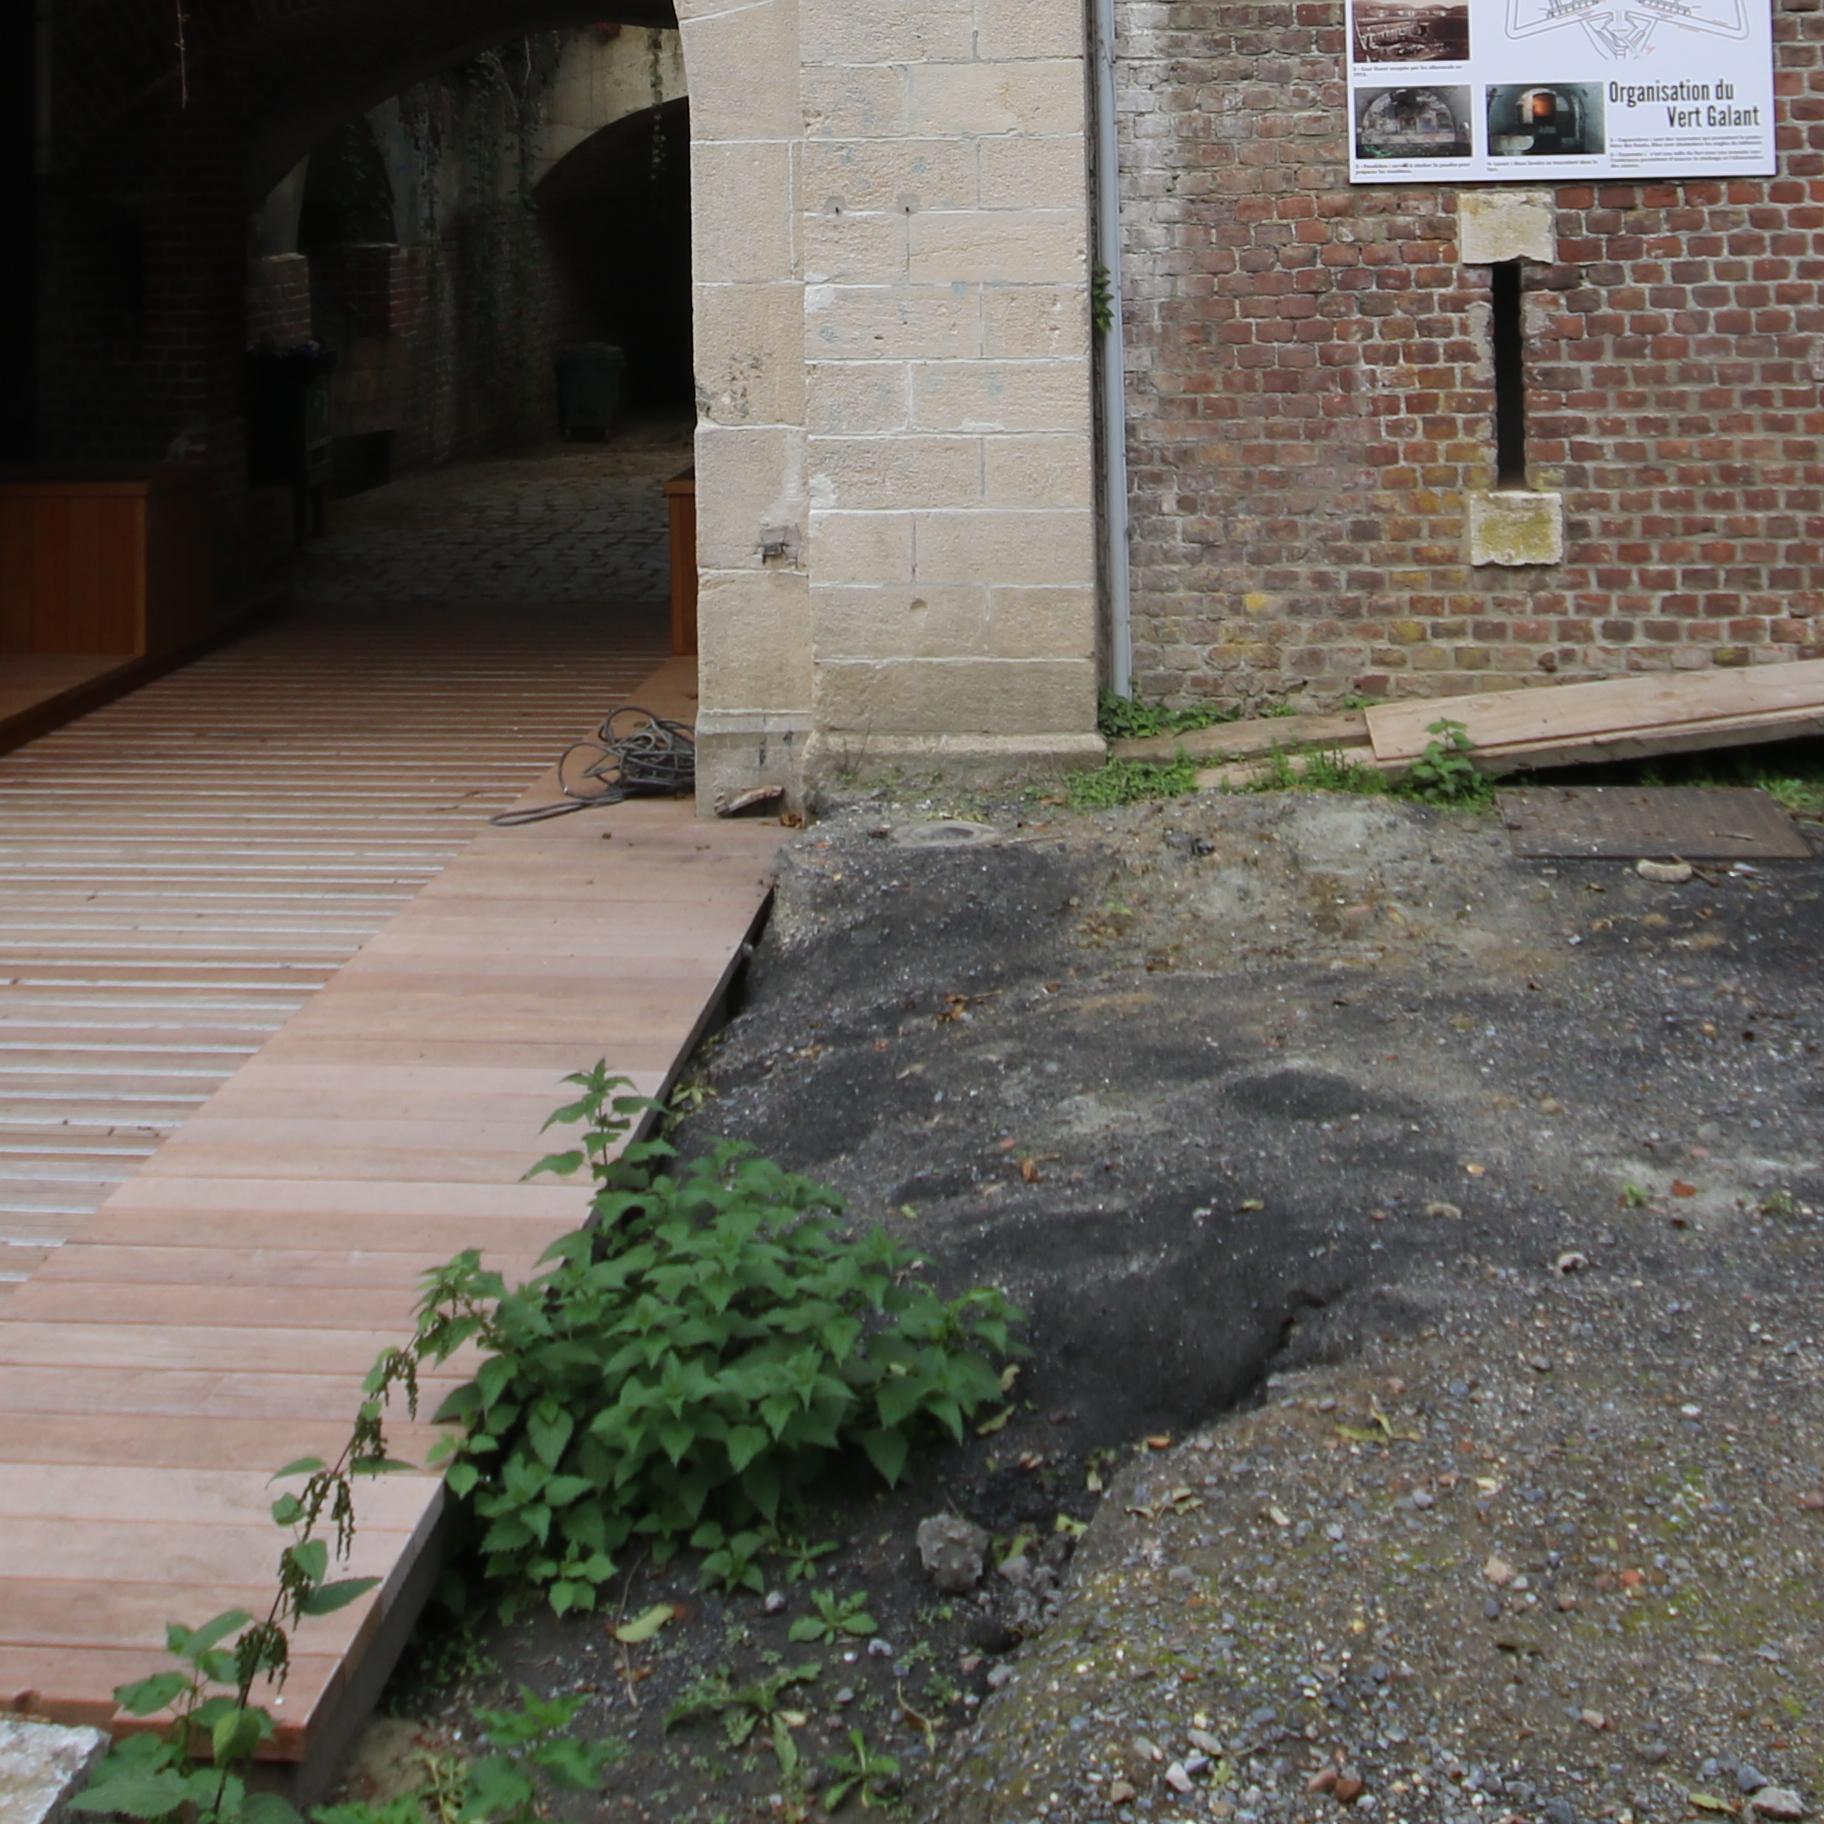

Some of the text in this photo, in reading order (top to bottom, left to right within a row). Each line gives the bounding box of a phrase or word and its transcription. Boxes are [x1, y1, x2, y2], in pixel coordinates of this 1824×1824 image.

[1609, 78, 1734, 108] Organisation du
[1667, 105, 1760, 128] Vert Galant
